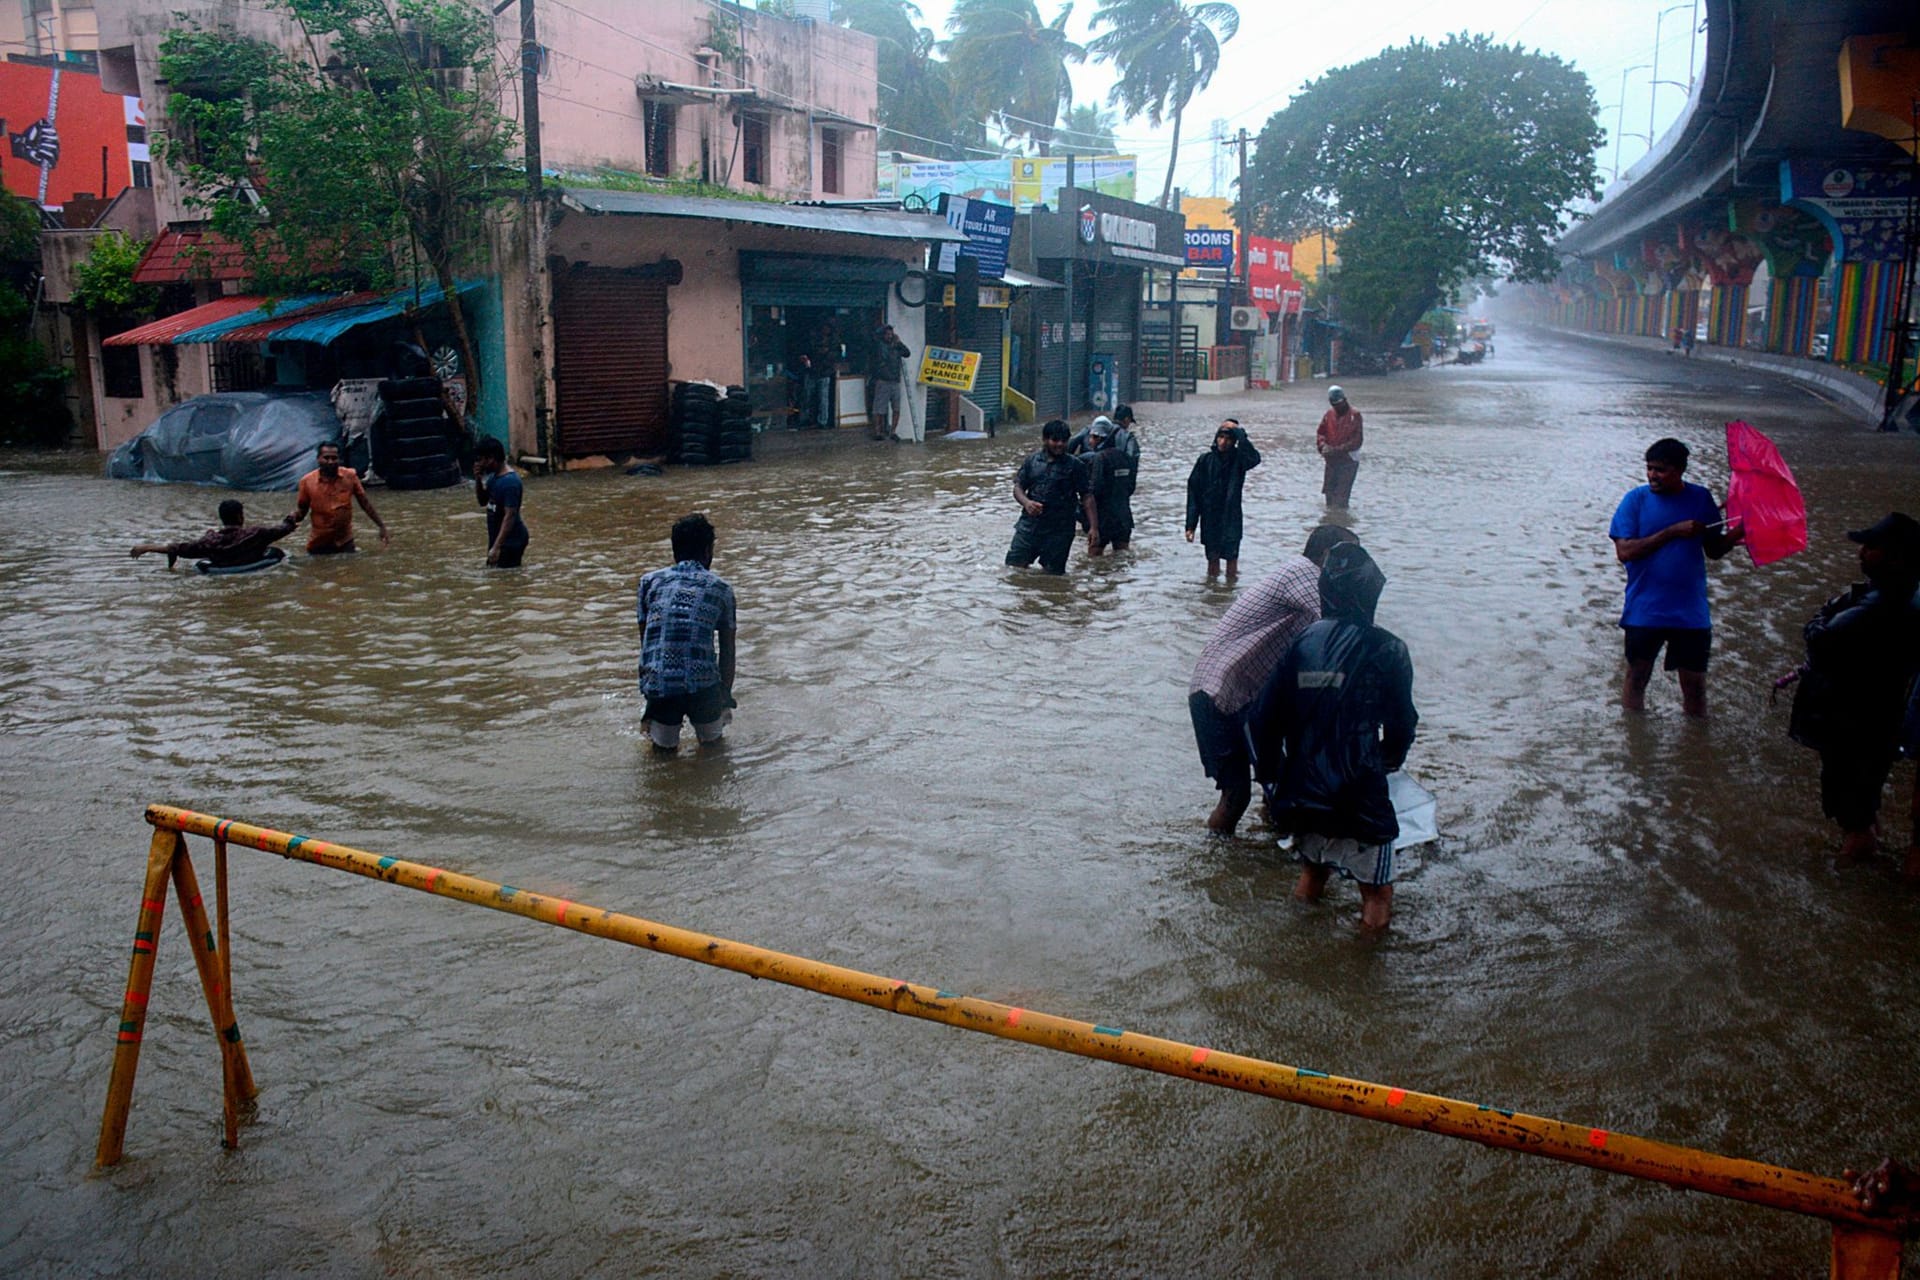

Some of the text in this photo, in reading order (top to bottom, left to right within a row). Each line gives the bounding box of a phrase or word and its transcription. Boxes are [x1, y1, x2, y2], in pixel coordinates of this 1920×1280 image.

[984, 208, 997, 222] AR
[965, 220, 982, 232] TOURS
[988, 224, 1011, 236] TRAVELS
[1184, 232, 1231, 246] ROOMS
[1187, 247, 1222, 260] BAR
[932, 360, 967, 372] MONEY
[924, 367, 970, 381] CHANGER
